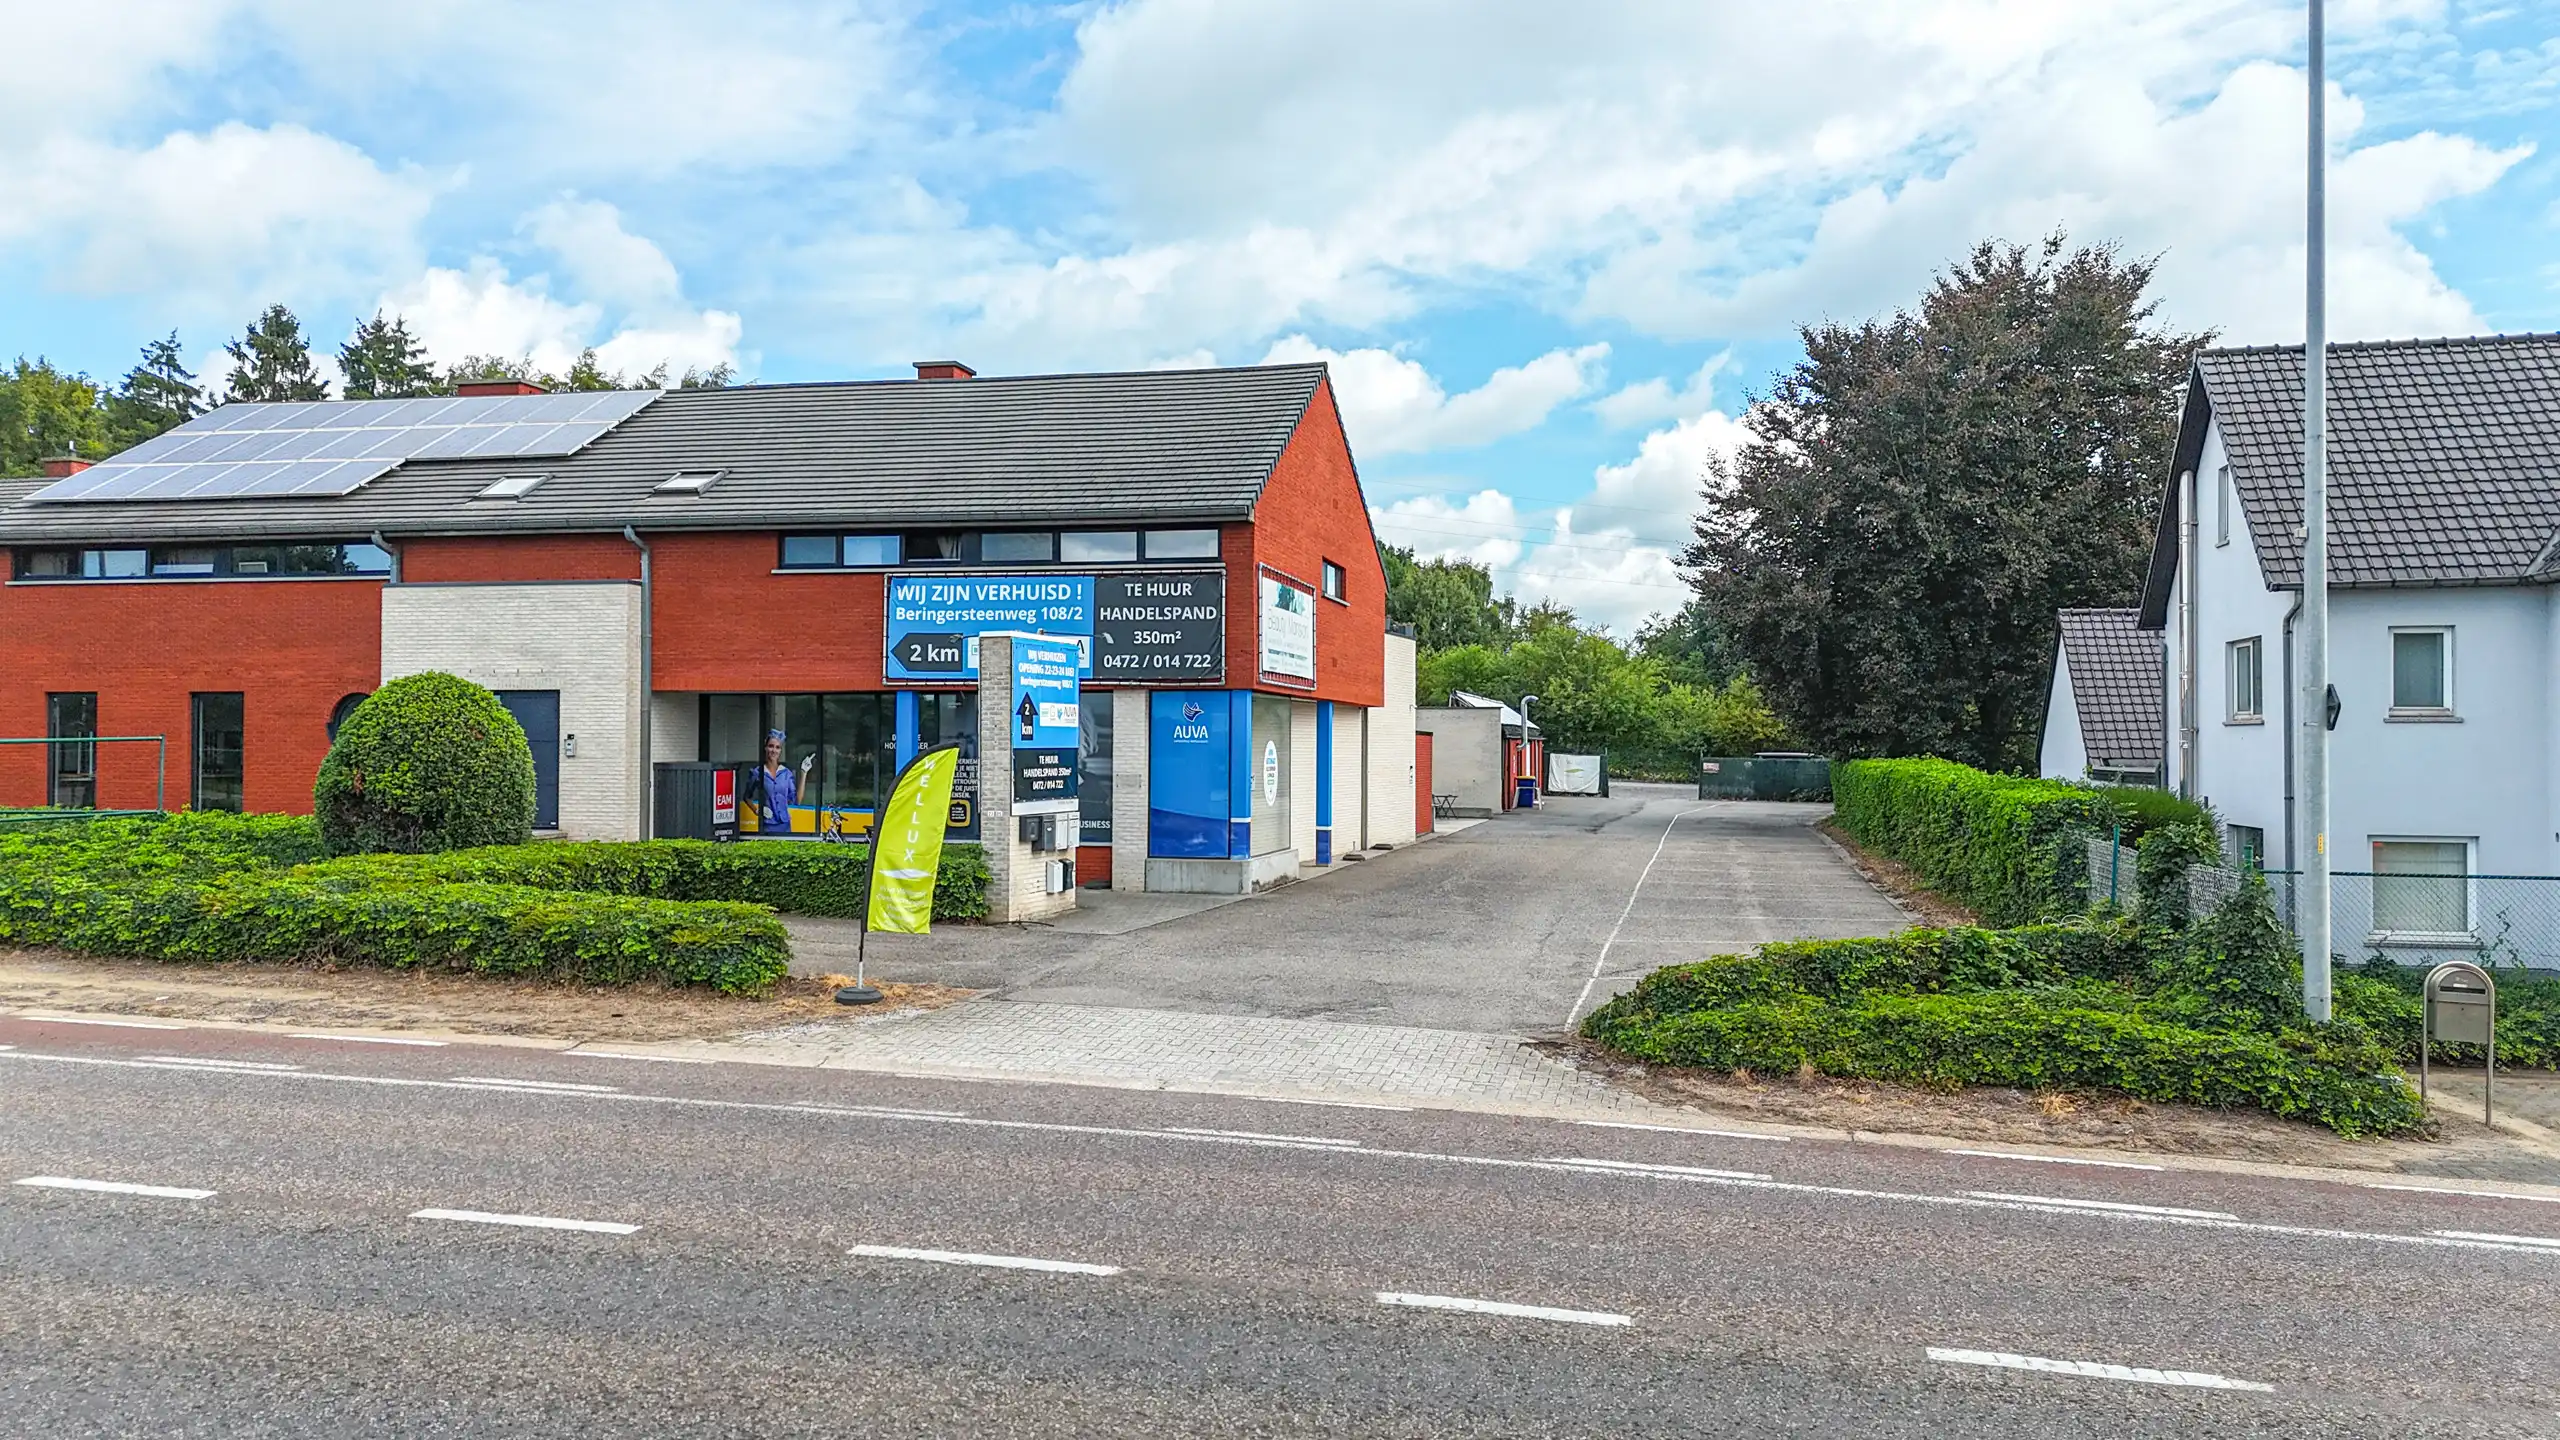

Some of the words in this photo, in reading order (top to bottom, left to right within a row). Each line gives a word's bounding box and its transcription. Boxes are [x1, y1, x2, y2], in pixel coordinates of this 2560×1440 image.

[897, 584, 926, 605] WIJ
[931, 584, 970, 605] ZIJN
[976, 584, 1071, 601] VERHUISD
[1077, 584, 1082, 600] !
[1124, 583, 1142, 597] TE
[1147, 583, 1193, 597] HUUR
[896, 607, 1037, 624] Beringersteenweg
[1041, 606, 1083, 620] 108/2
[1100, 606, 1217, 620] HANDELSPAND
[1133, 630, 1182, 644] 350m²
[910, 644, 922, 662] 2
[928, 643, 959, 662] km
[1038, 650, 1066, 663] VERHUIZEN
[1103, 655, 1140, 668] 0472
[1143, 655, 1150, 668] /
[1153, 655, 1181, 668] 014
[1184, 654, 1212, 668] 722
[1018, 662, 1044, 674] OPENING
[1024, 703, 1030, 715] 2
[1021, 722, 1033, 735] km
[1173, 725, 1209, 739] AUVA
[1039, 755, 1045, 765] TE
[1045, 755, 1058, 764] HUUR
[1023, 768, 1058, 777] HANDELSPAND
[963, 785, 978, 793] JUIST
[717, 794, 732, 806] EAM
[1079, 820, 1111, 829] USINESS
